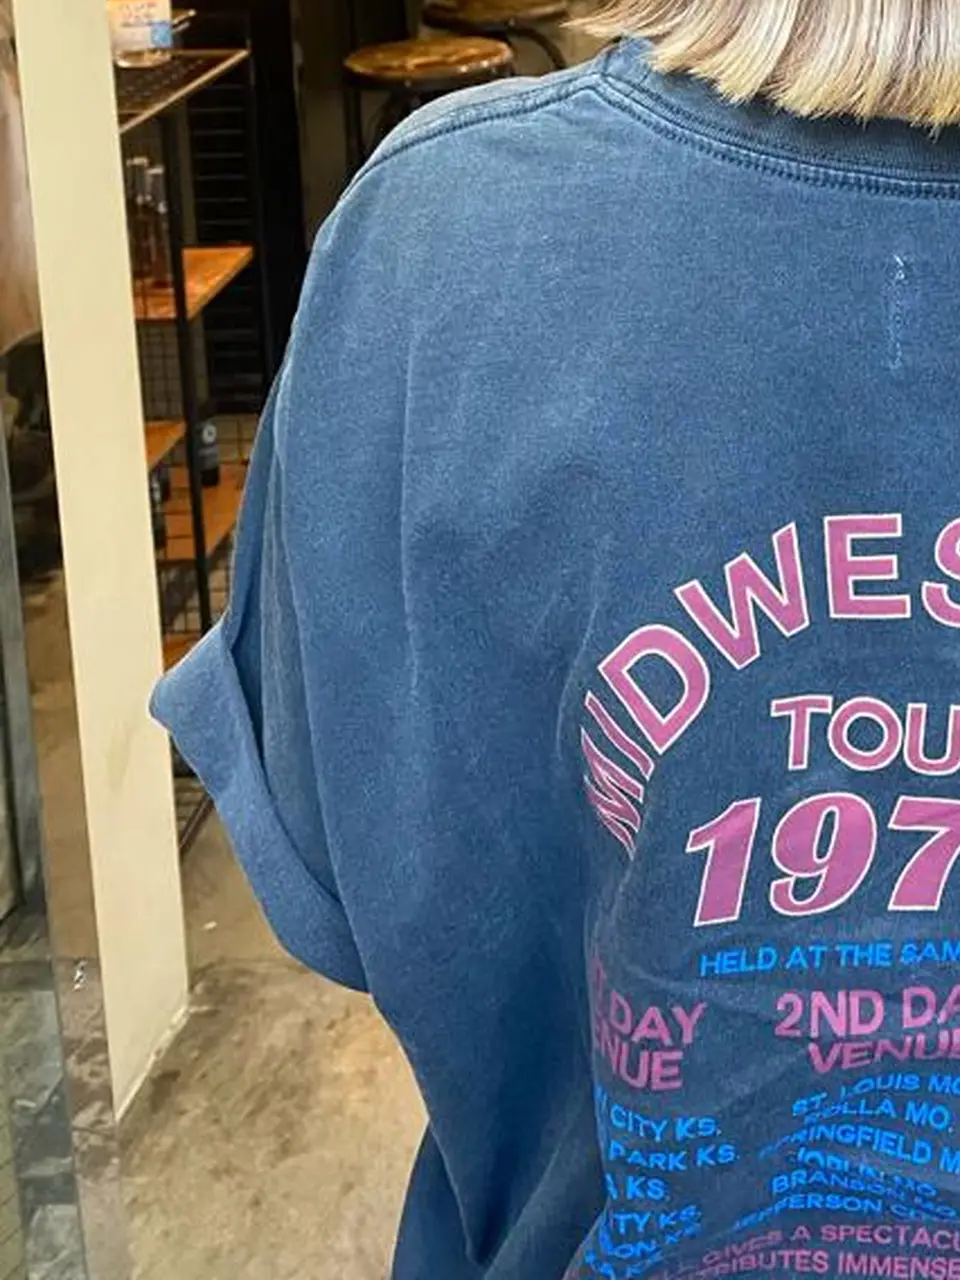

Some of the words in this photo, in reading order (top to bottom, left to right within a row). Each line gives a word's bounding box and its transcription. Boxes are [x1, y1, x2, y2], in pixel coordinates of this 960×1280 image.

[700, 945, 777, 977] HELD
[786, 944, 829, 970] AT
[836, 942, 893, 968] THE
[610, 988, 707, 1047] DAY
[774, 989, 885, 1039] 2ND
[610, 1103, 668, 1143] CITY
[790, 1226, 811, 1241] A
